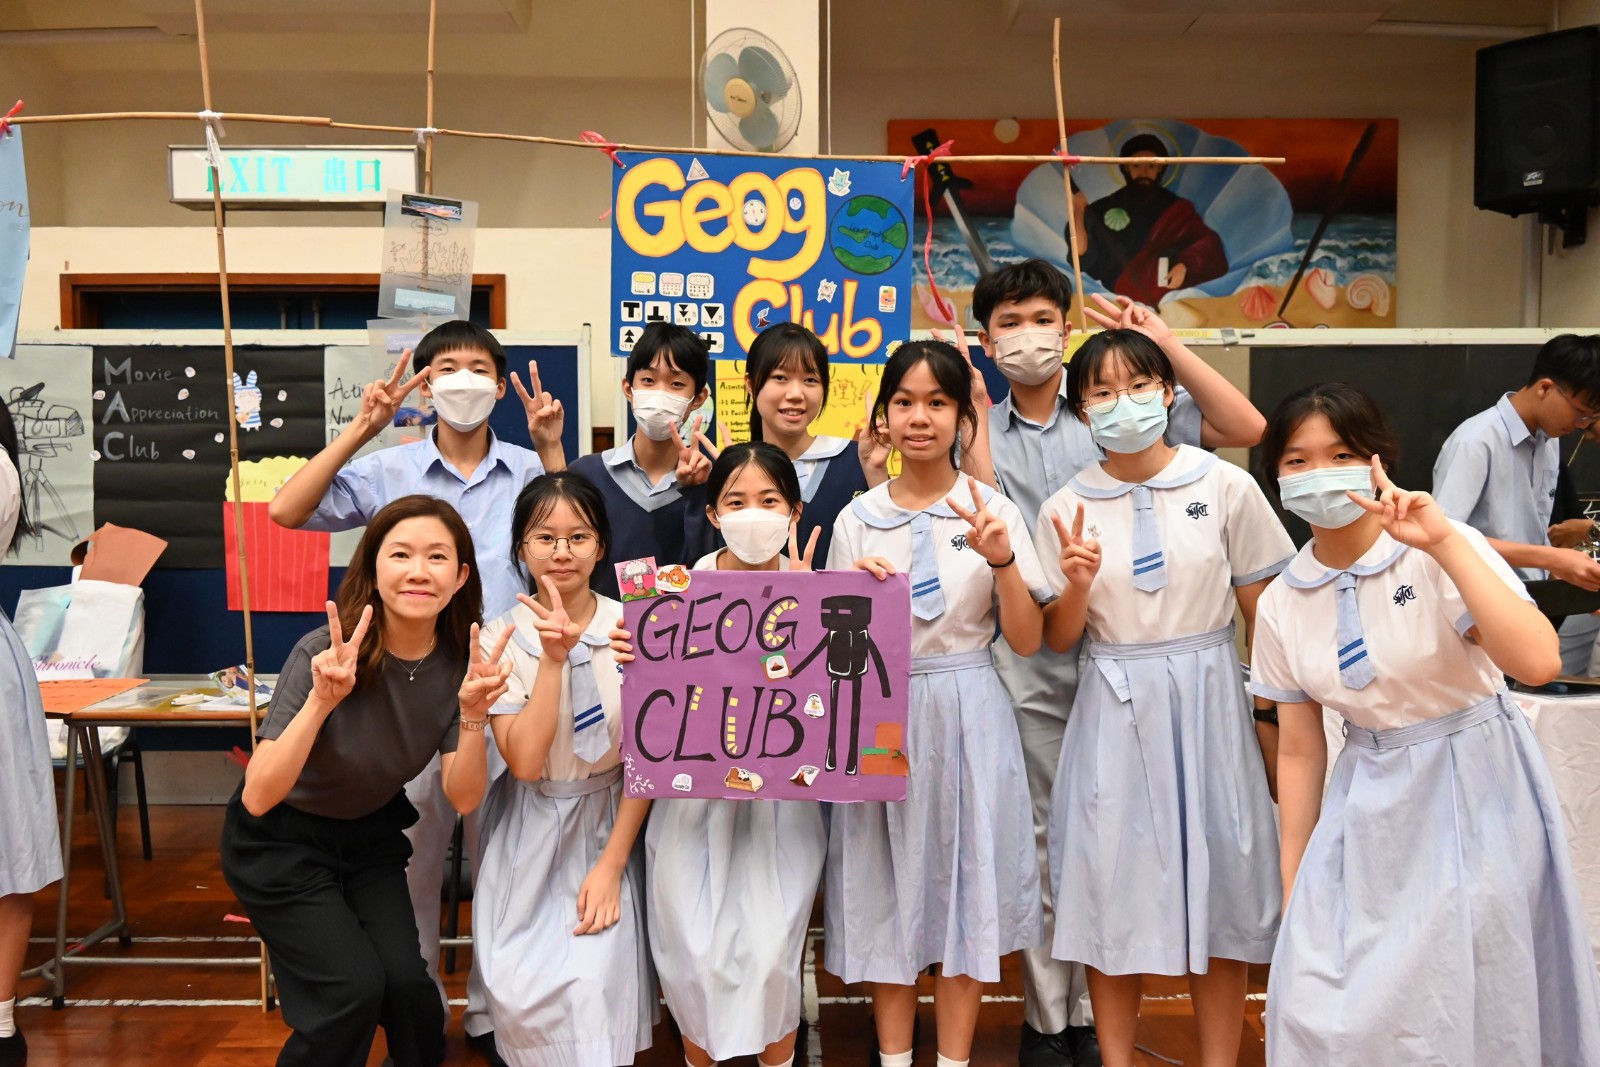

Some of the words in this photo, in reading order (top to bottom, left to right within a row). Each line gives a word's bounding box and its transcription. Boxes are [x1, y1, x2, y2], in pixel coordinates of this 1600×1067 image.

[323, 157, 382, 192] 出口
[615, 157, 827, 282] Geog
[849, 222, 888, 243] Geography
[864, 241, 879, 251] Club
[732, 277, 883, 359] Club
[104, 356, 177, 386] Movie
[101, 390, 220, 425] Appreciation
[103, 431, 160, 461] Club
[637, 592, 799, 662] GEOG
[634, 685, 805, 763] CLUB
